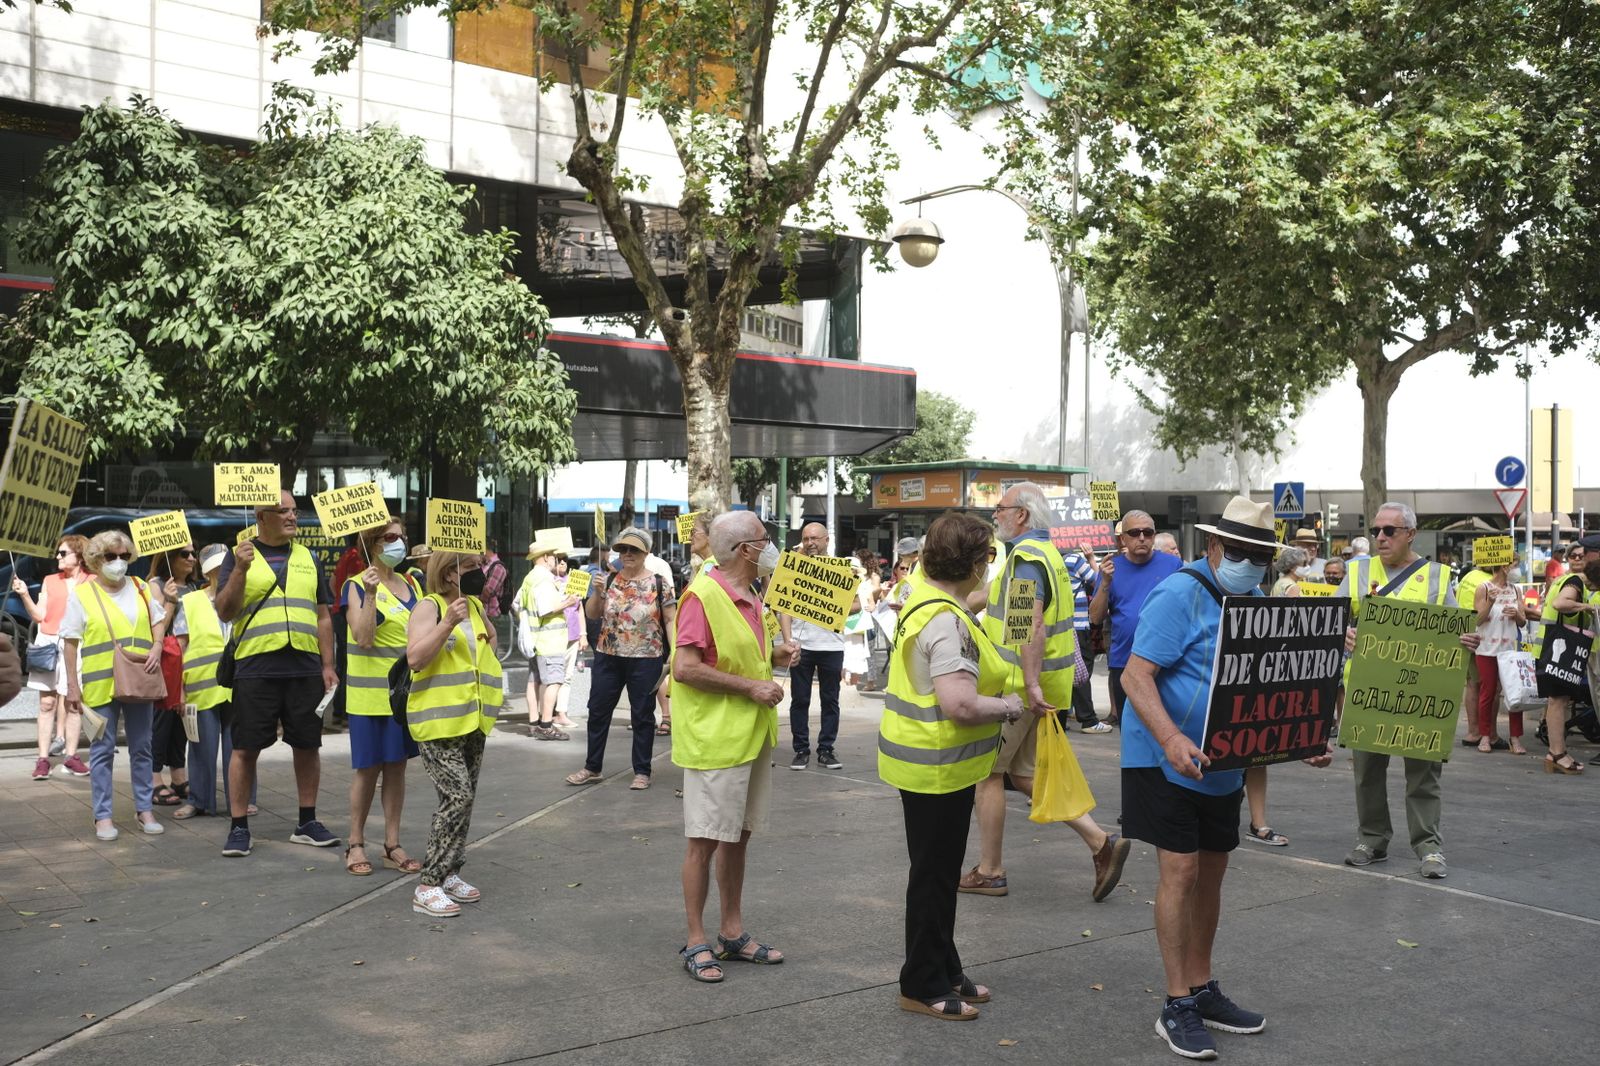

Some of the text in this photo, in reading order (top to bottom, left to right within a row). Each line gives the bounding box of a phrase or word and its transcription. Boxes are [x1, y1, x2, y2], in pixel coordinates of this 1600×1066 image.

[18, 401, 86, 460] LA SALUD
[9, 441, 29, 482] NO
[27, 448, 46, 487] SE
[43, 455, 80, 498] VENDE
[220, 466, 275, 475] SI TE AMAS
[228, 483, 268, 493] PODRÁN
[241, 475, 254, 484] NO
[220, 493, 277, 502] MALTRATARTE
[319, 484, 376, 507] SI LA MATAS
[330, 497, 374, 519] TAMBIÉN
[441, 503, 472, 515] NI UNA
[1048, 498, 1091, 511] UZ, AG
[141, 514, 174, 527] TRABAJO
[328, 511, 386, 535] NOS MATAS
[435, 513, 479, 528] AGRESIÓN
[1058, 510, 1066, 521] Y
[139, 522, 180, 537] DEL HOGAR
[441, 526, 472, 538] NI UNA
[1049, 525, 1110, 537] DERECHO
[139, 531, 188, 553] REMUNERADO
[431, 537, 483, 551] MUERTE MÁS
[782, 555, 854, 591] LA HUMANIDAD
[793, 577, 834, 599] CONTRA
[775, 584, 844, 615] LA VIOLENCIA
[777, 598, 834, 625] DE GÉNERO
[1007, 615, 1033, 627] GANAMOS
[1229, 606, 1344, 640] VIOLENCIA
[1575, 645, 1589, 659] NO
[1219, 643, 1340, 686] DE GÉNERO
[1571, 659, 1583, 672] AL
[1396, 668, 1420, 685] DE
[1545, 663, 1581, 686] RACISM
[1230, 688, 1319, 724] LACRA
[1209, 720, 1327, 760] SOCIAL
[1351, 725, 1366, 743] Y
